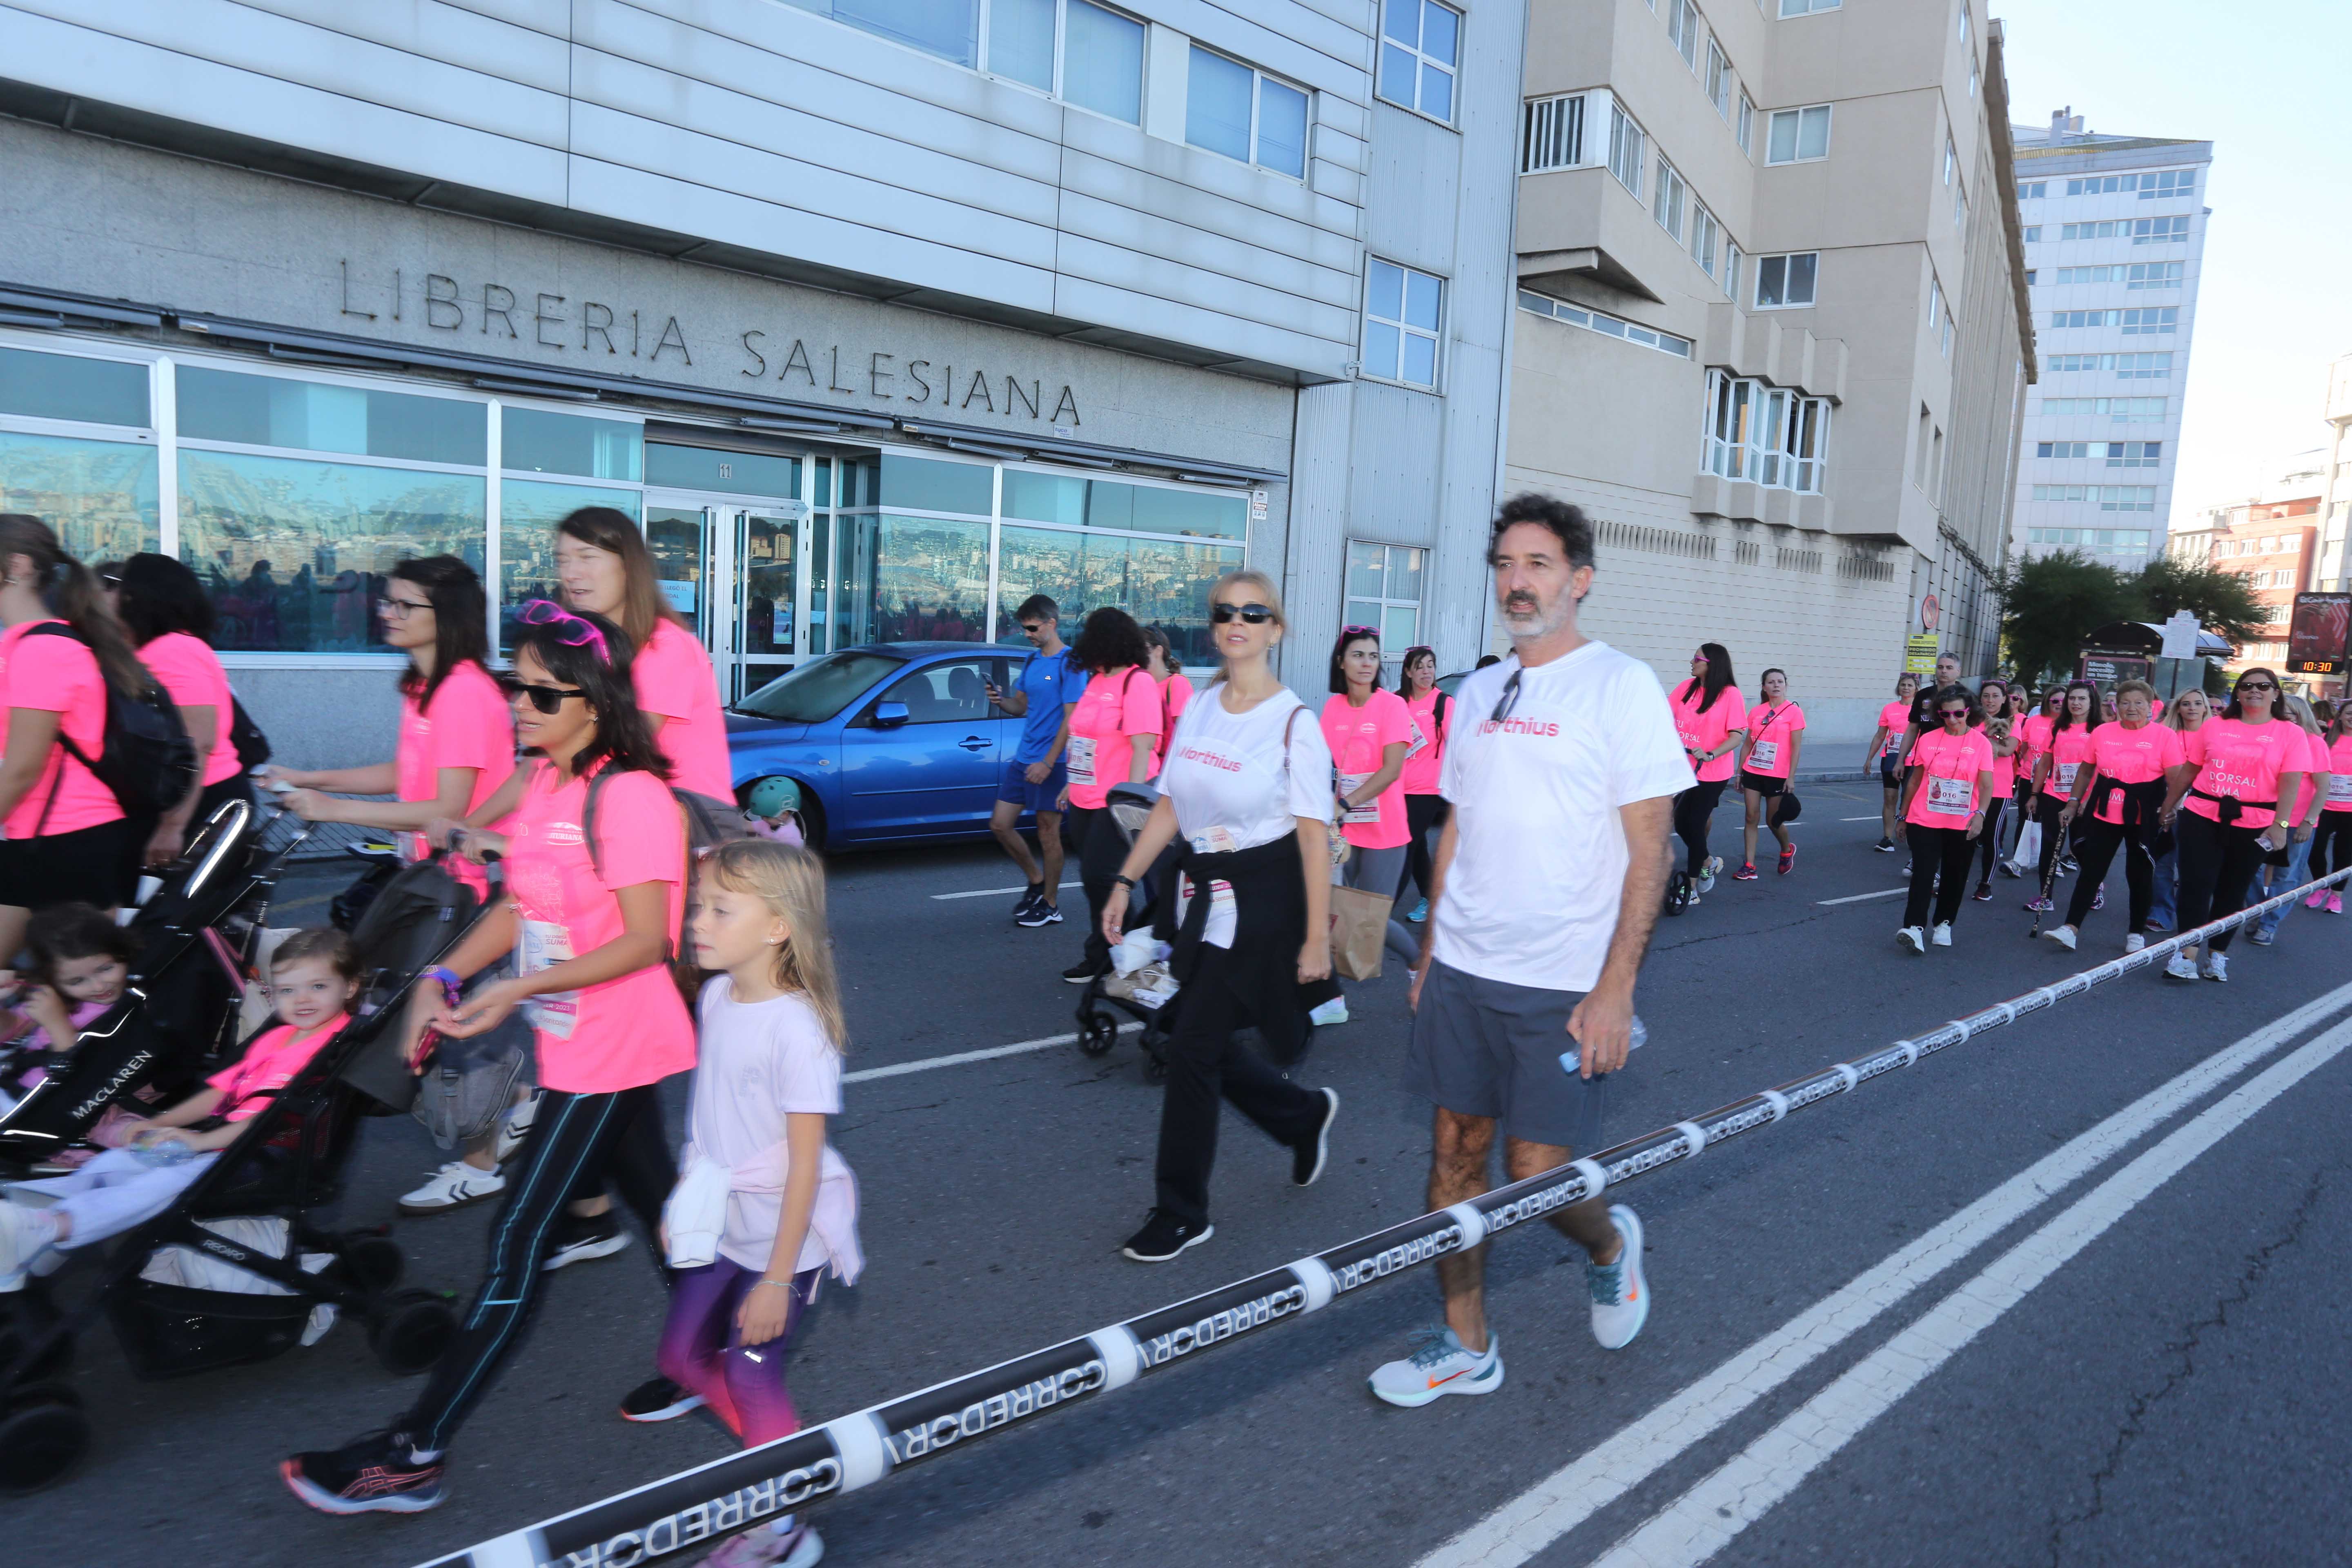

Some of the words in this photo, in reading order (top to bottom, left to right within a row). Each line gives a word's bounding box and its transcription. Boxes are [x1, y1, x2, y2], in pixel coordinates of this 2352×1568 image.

[340, 258, 694, 367] LIBRERIA
[740, 328, 1082, 427] SALESIANA
[720, 464, 731, 477] 11
[2303, 662, 2332, 672] 10:30
[1679, 731, 1700, 742] ORSAL
[2211, 759, 2225, 768] TU
[2102, 768, 2114, 777] TU
[2209, 771, 2256, 788] DORSAL
[72, 1050, 153, 1120] MACLAREN
